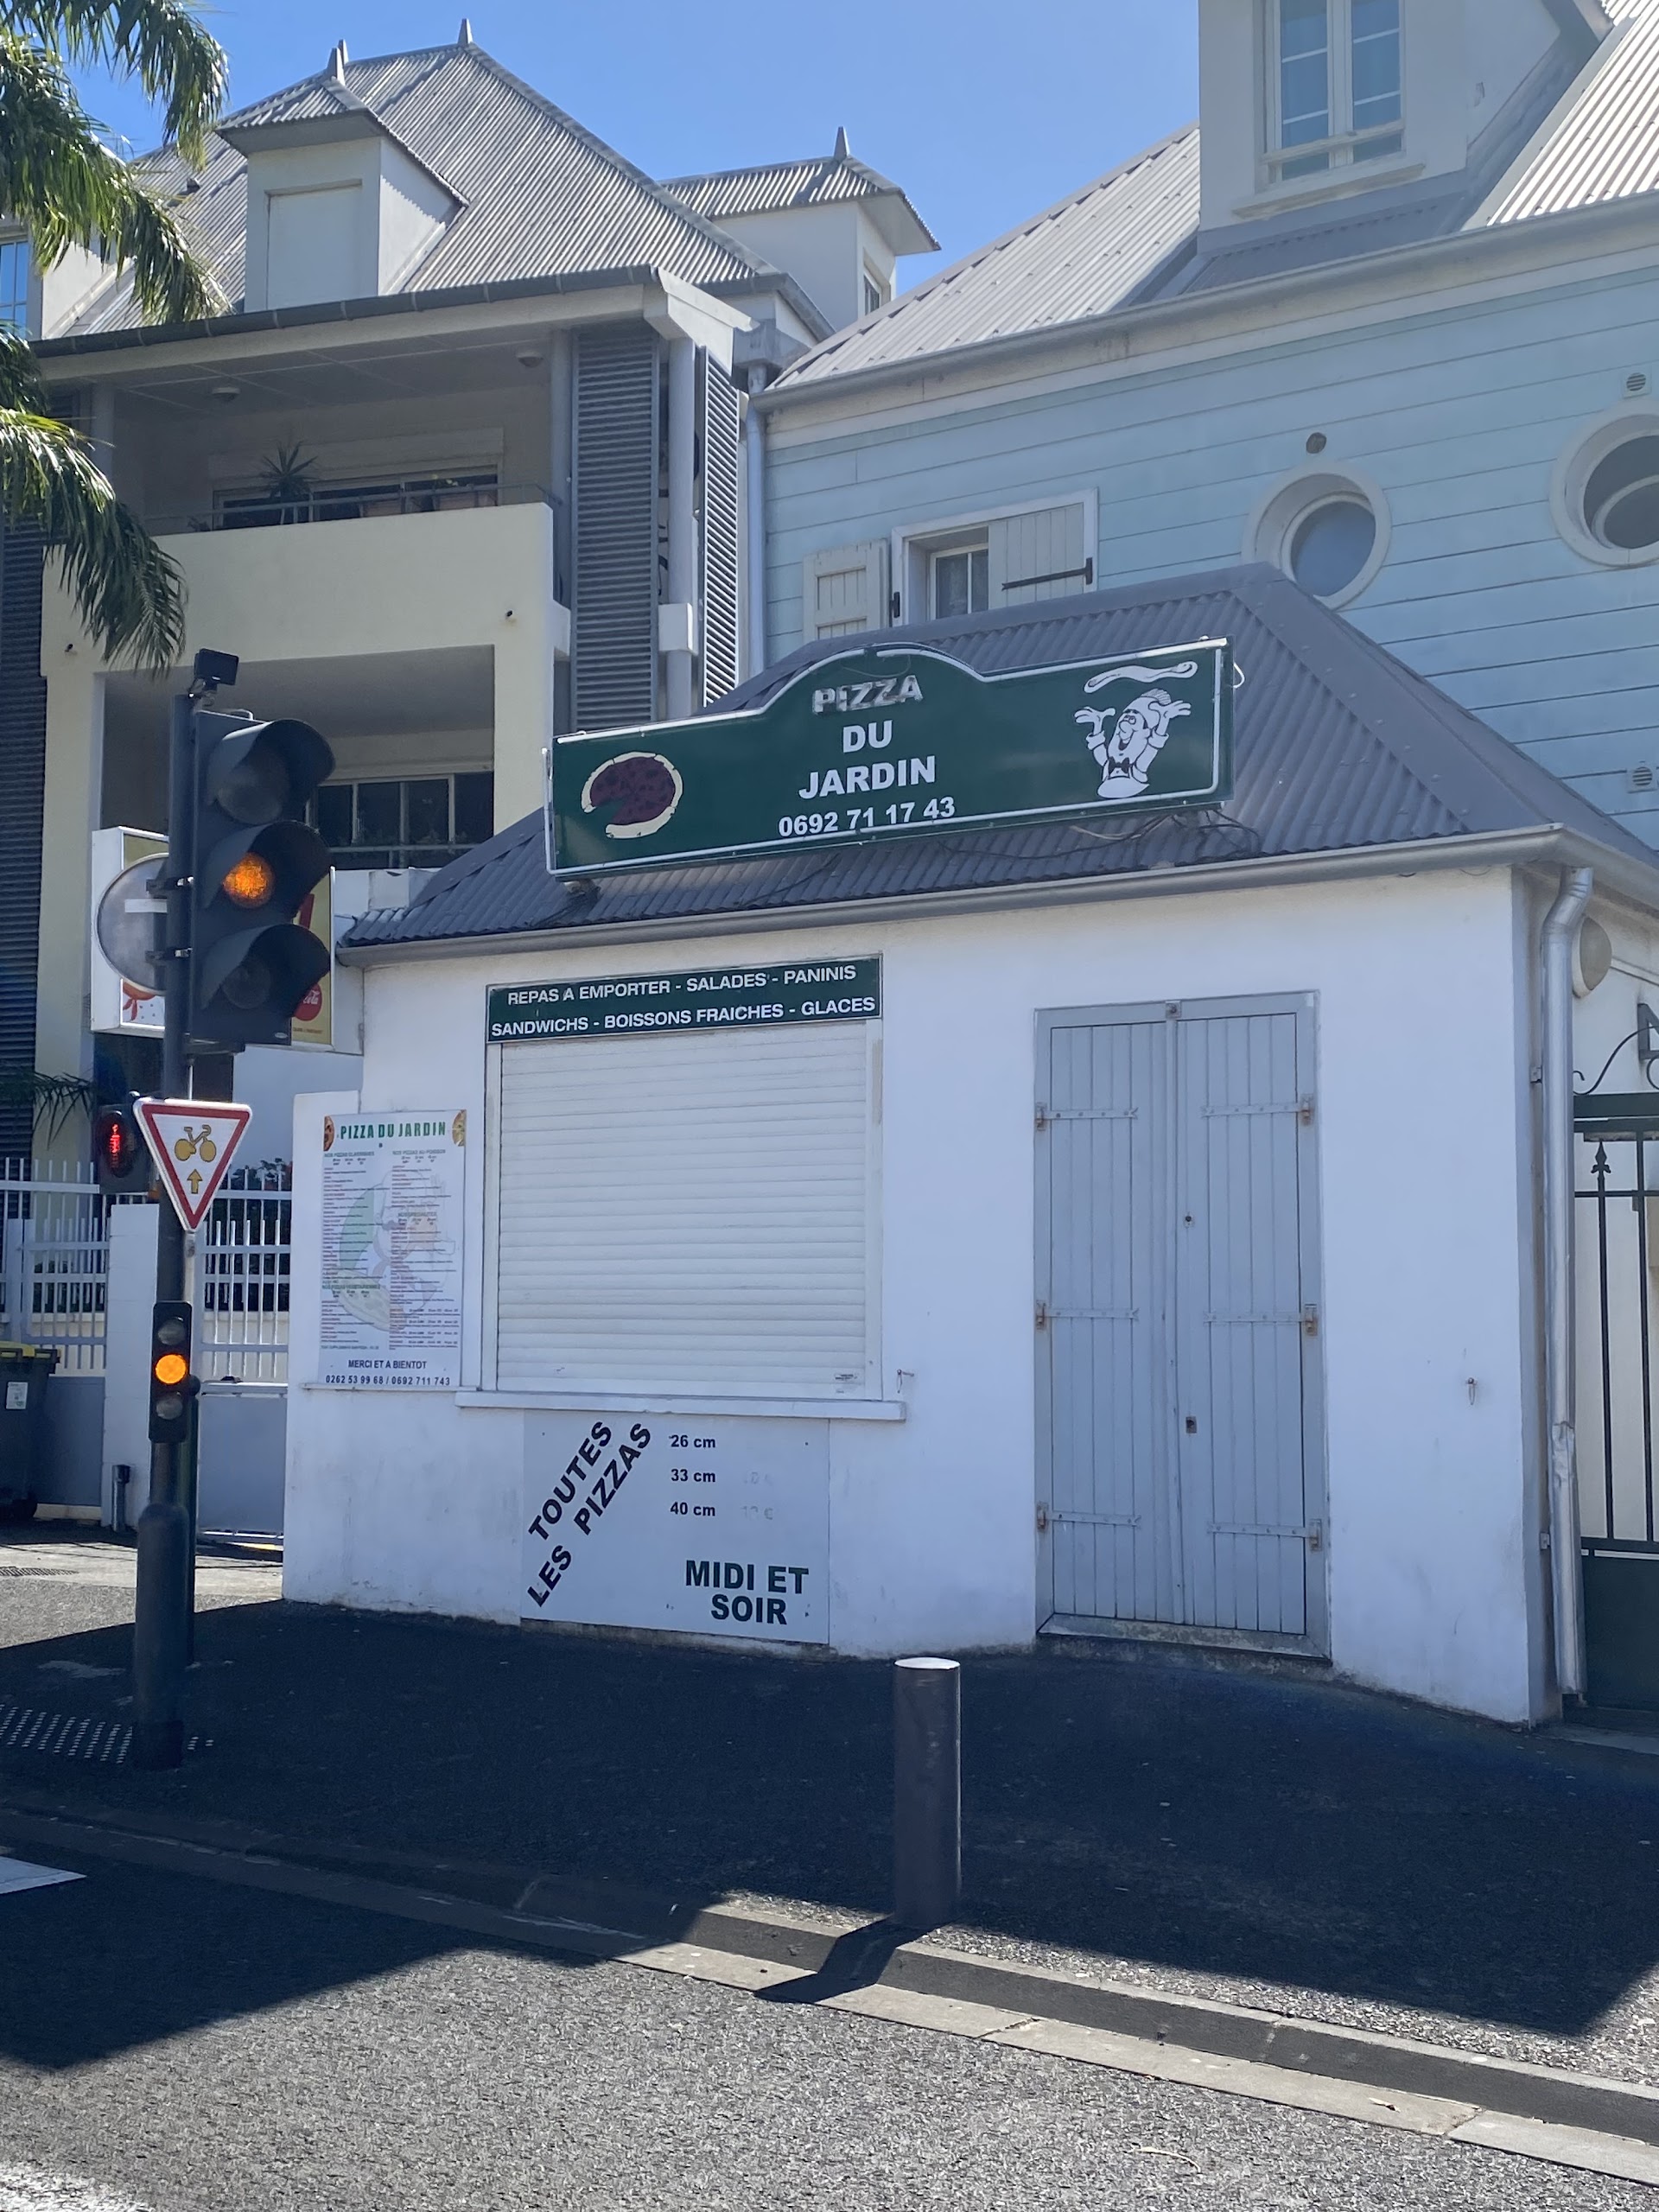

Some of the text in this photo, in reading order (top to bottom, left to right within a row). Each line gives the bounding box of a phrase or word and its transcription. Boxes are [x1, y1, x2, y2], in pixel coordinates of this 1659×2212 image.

[812, 675, 923, 715] PIZZA
[842, 720, 893, 753] DU
[798, 755, 936, 799] JARDIN
[779, 797, 956, 836] 0692 71 17 43
[507, 988, 559, 1006] REPAS
[563, 987, 575, 1001] A
[579, 980, 671, 1001] EMPORTER
[686, 973, 767, 993] SALADES
[784, 965, 856, 985] PANINIS
[491, 1017, 588, 1037] SANDWICHS
[604, 1010, 691, 1030] BOISSONS
[696, 1003, 784, 1023] FRAICHES
[801, 996, 875, 1016] GLACES
[340, 1122, 446, 1140] PIZZA DU JARDIN
[326, 1375, 345, 1383] 0262
[348, 1375, 358, 1383] 53
[360, 1376, 371, 1384] 99
[373, 1376, 383, 1384] 68
[391, 1376, 413, 1385] 0692
[416, 1376, 430, 1385] 711
[435, 1376, 450, 1386] 743
[385, 1360, 391, 1369] A
[671, 1434, 715, 1448] 26 cm
[528, 1421, 612, 1540] TOUTES
[671, 1469, 715, 1483] 33 cm
[527, 1423, 651, 1607] LES PIZZAS
[670, 1502, 689, 1516] 40
[693, 1506, 715, 1516] cm
[685, 1560, 809, 1594] MIDI ET
[710, 1593, 787, 1625] SOIR
